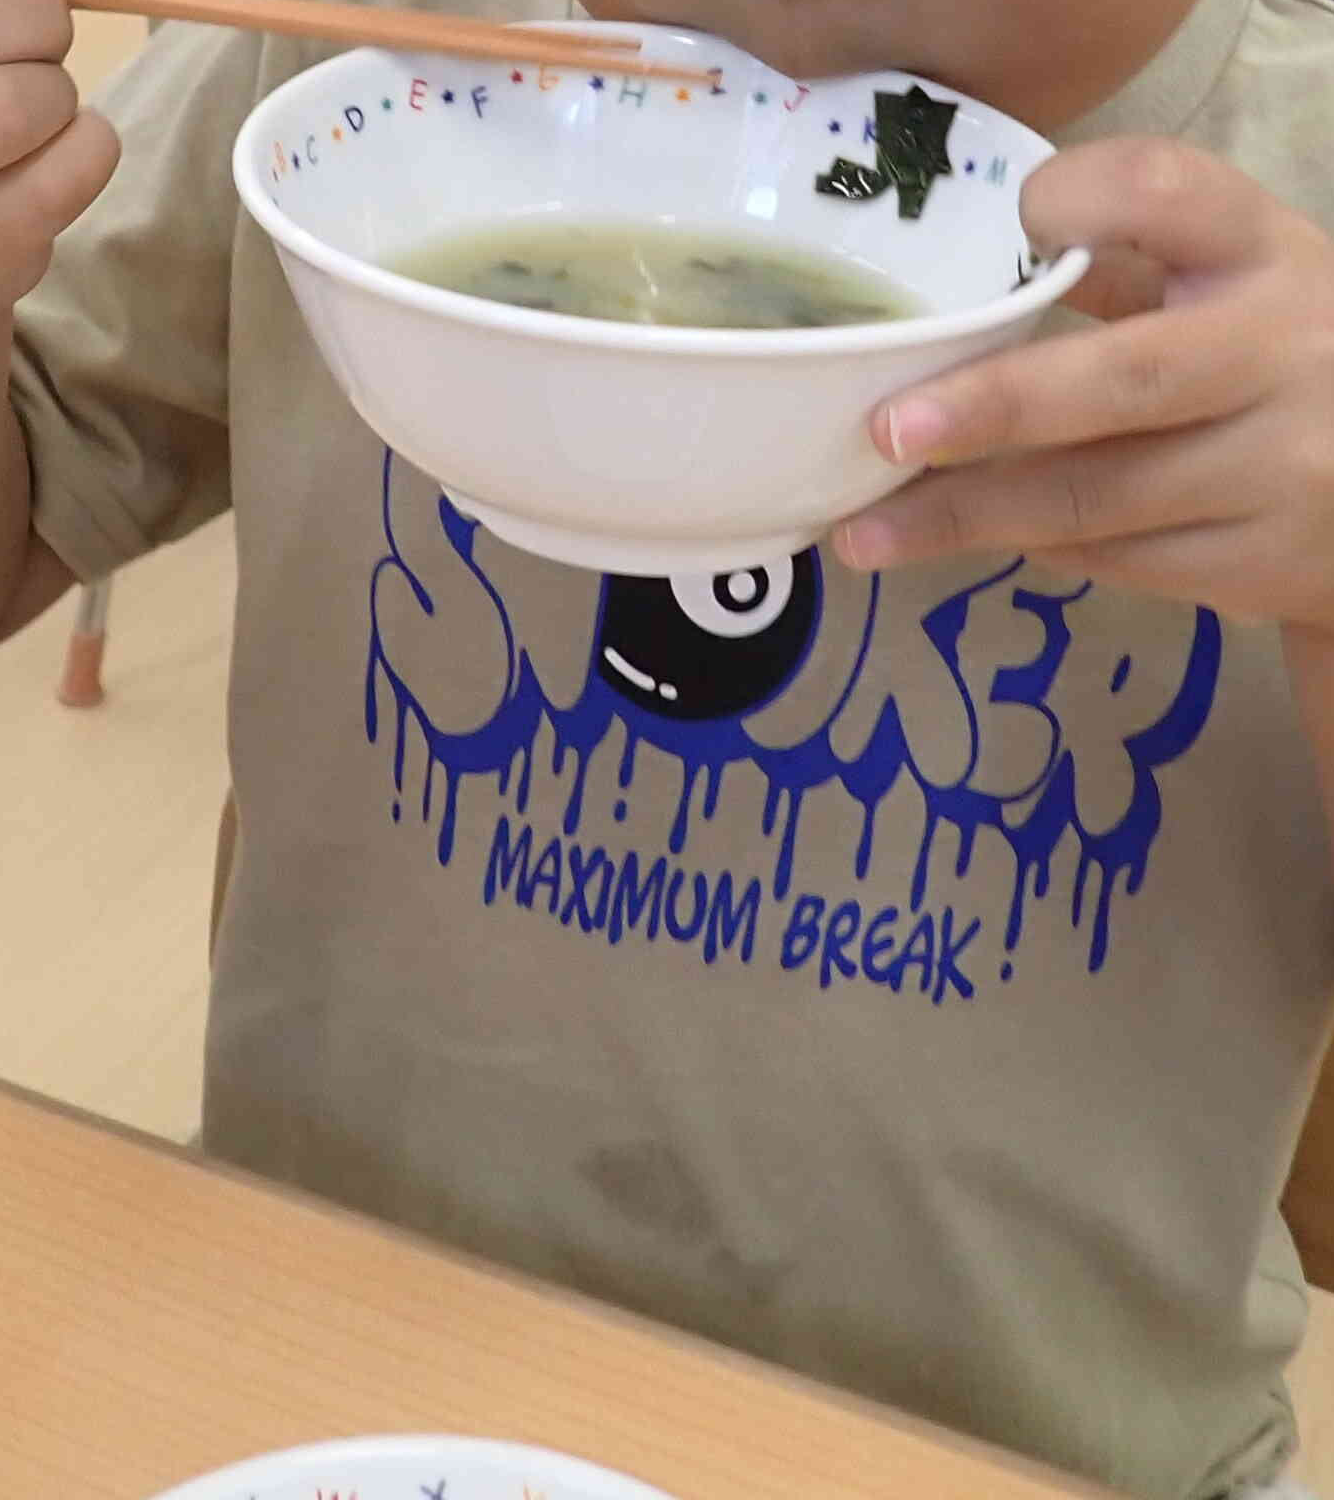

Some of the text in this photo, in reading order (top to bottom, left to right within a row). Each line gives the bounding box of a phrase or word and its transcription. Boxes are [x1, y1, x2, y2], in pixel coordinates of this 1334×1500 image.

[343, 105, 365, 133] D
[409, 78, 428, 111] E
[470, 84, 489, 119] F
[618, 75, 647, 108] H
[783, 84, 810, 113] J
[484, 813, 981, 1005] MAXIMUM BREAK
